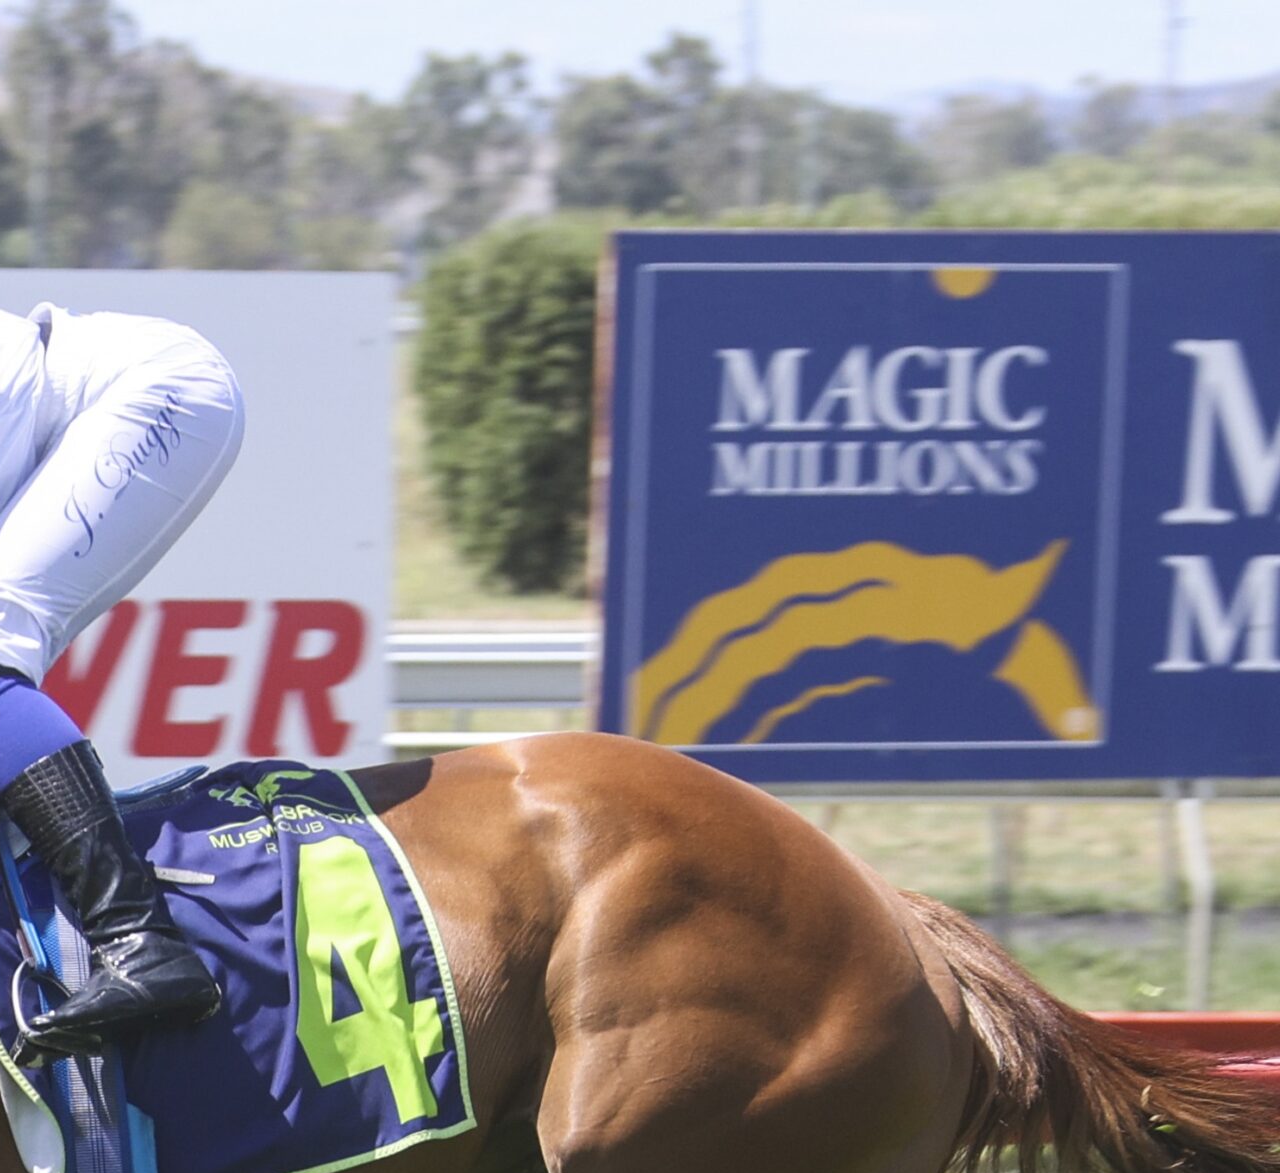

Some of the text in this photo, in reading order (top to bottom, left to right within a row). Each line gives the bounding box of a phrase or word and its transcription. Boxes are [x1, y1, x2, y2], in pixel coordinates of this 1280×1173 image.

[710, 344, 1050, 432] MAGIC
[94, 386, 182, 501] Dugga
[709, 438, 1044, 496] MILLIONS
[295, 835, 445, 1125] 4
